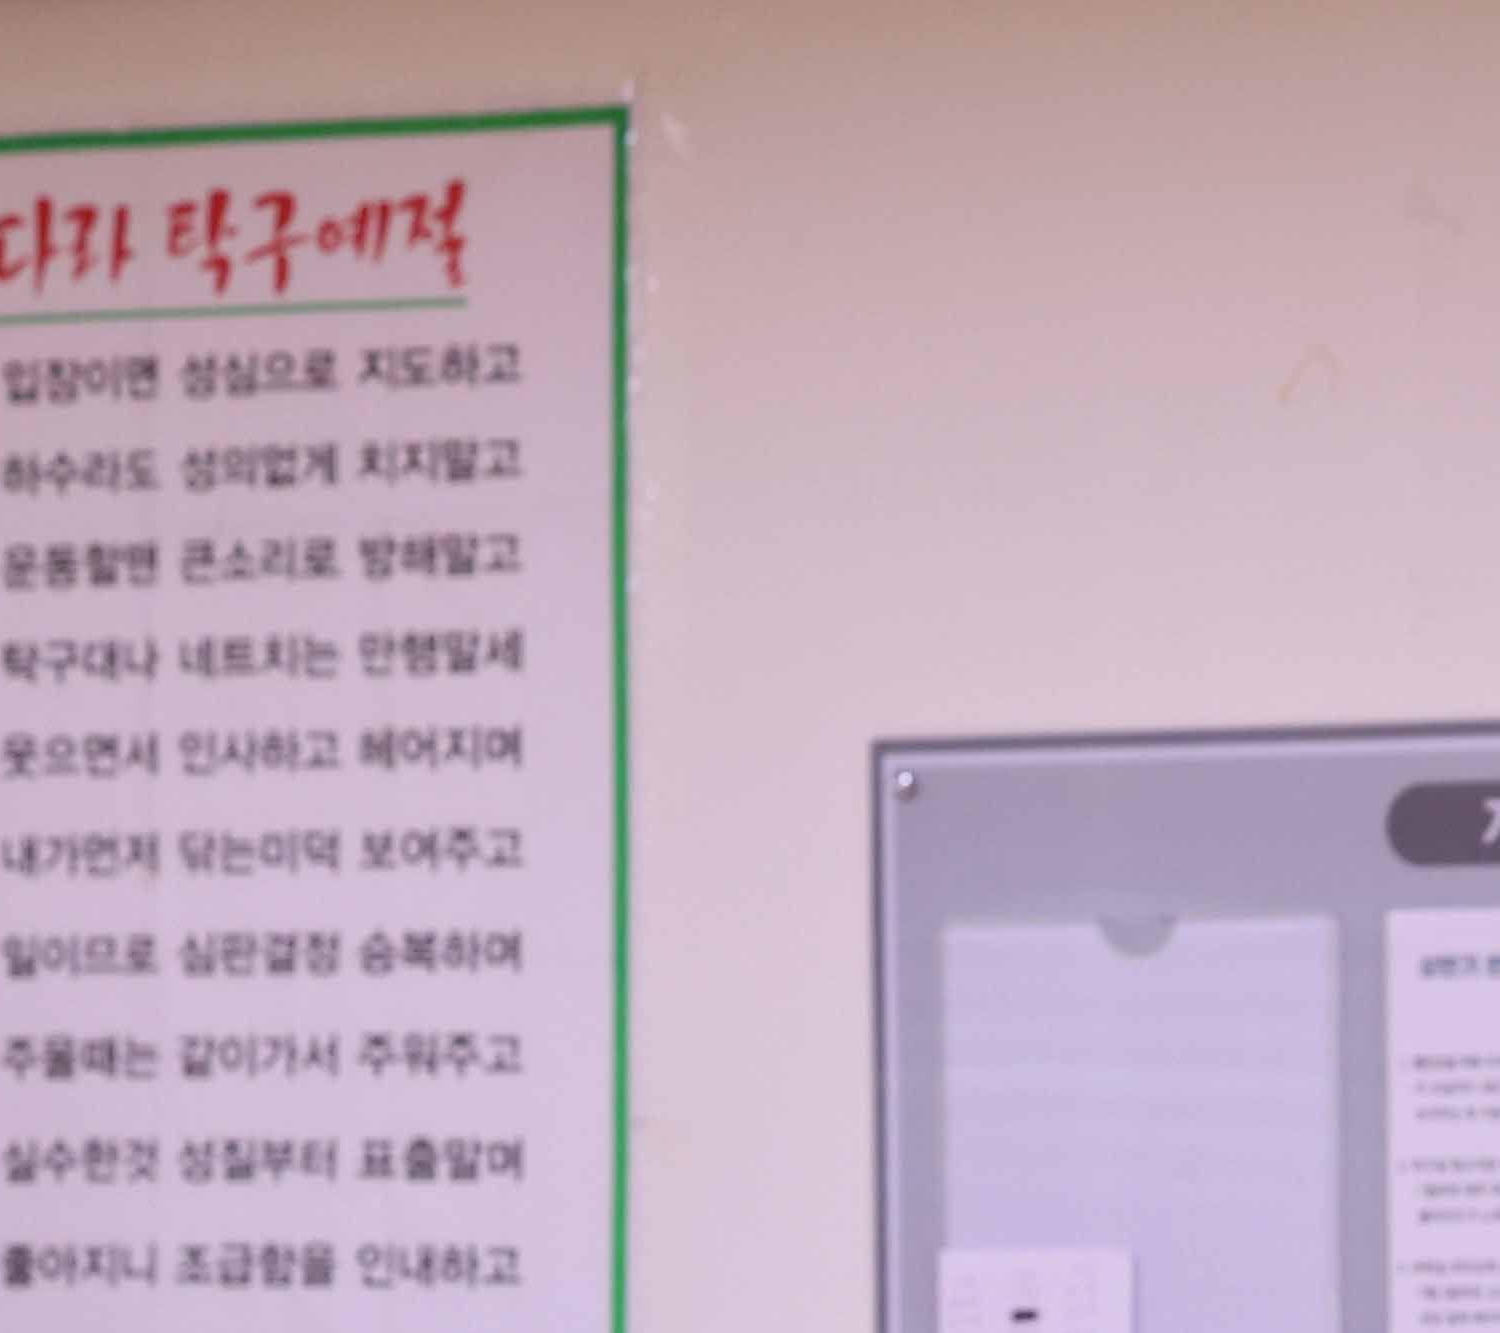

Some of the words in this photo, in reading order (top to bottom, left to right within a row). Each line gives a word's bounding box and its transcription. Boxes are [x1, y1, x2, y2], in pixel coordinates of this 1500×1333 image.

[165, 178, 470, 295] 탁구예절
[2, 353, 160, 406] 입장이면
[180, 348, 338, 400] 성심으로
[359, 343, 520, 389] 지도하고
[1, 448, 159, 496] 하수라도
[357, 438, 521, 485] 치지말고
[180, 536, 340, 585] 큰소리로
[358, 532, 520, 581] 방해말고
[1, 637, 160, 683] 탁구대나
[178, 633, 340, 680] 네트치는
[1, 731, 159, 779] 웃으면서
[177, 728, 340, 776] 인사하고
[1, 832, 160, 877] 내가먼저
[361, 826, 522, 870] 보여주고
[0, 933, 157, 981] 일이므로
[178, 931, 341, 978] 심판결정
[1, 1035, 157, 1082] 주울때는
[178, 1034, 340, 1081] 같이가서
[357, 1032, 522, 1077] 주워주고
[2, 1136, 159, 1186] 실수한것
[178, 1138, 337, 1184] 성질부터
[1, 1242, 156, 1289] 좋아지니
[177, 1242, 336, 1289] 조급함을
[355, 1243, 521, 1289] 인내하고
